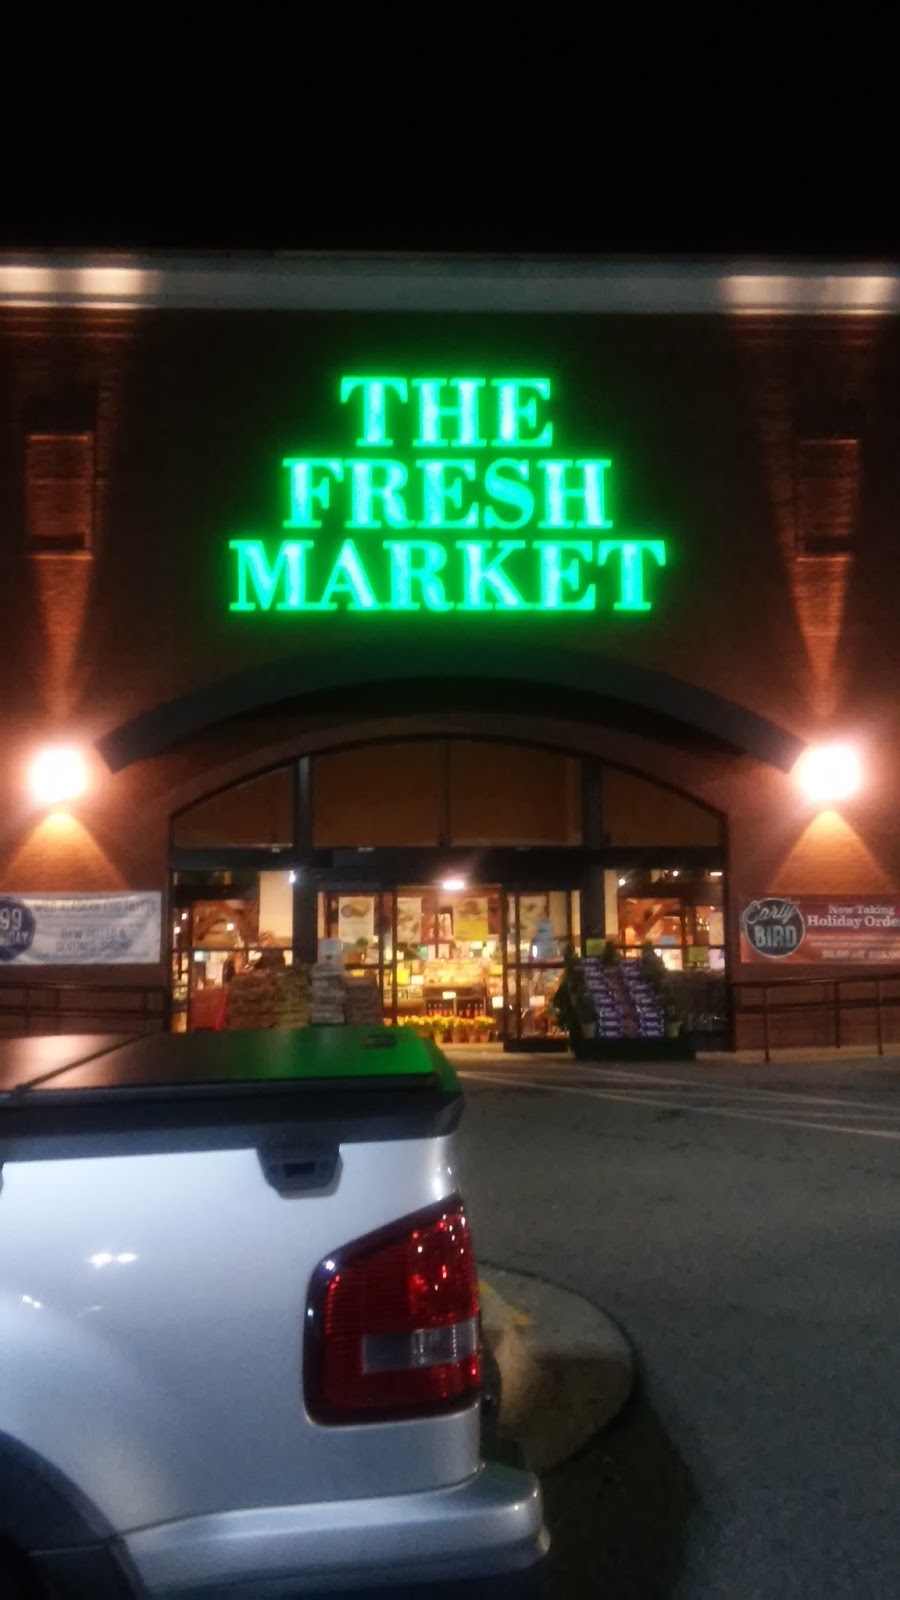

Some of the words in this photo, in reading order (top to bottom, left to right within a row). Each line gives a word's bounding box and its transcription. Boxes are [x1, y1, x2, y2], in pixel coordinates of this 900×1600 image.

[340, 375, 554, 448] THE
[282, 457, 613, 530] FRESH
[229, 538, 667, 611] MARKET
[742, 900, 799, 925] Early
[807, 914, 863, 930] Holiday
[828, 904, 853, 915] Now
[858, 904, 896, 917] Taking
[753, 924, 798, 948] BIRD
